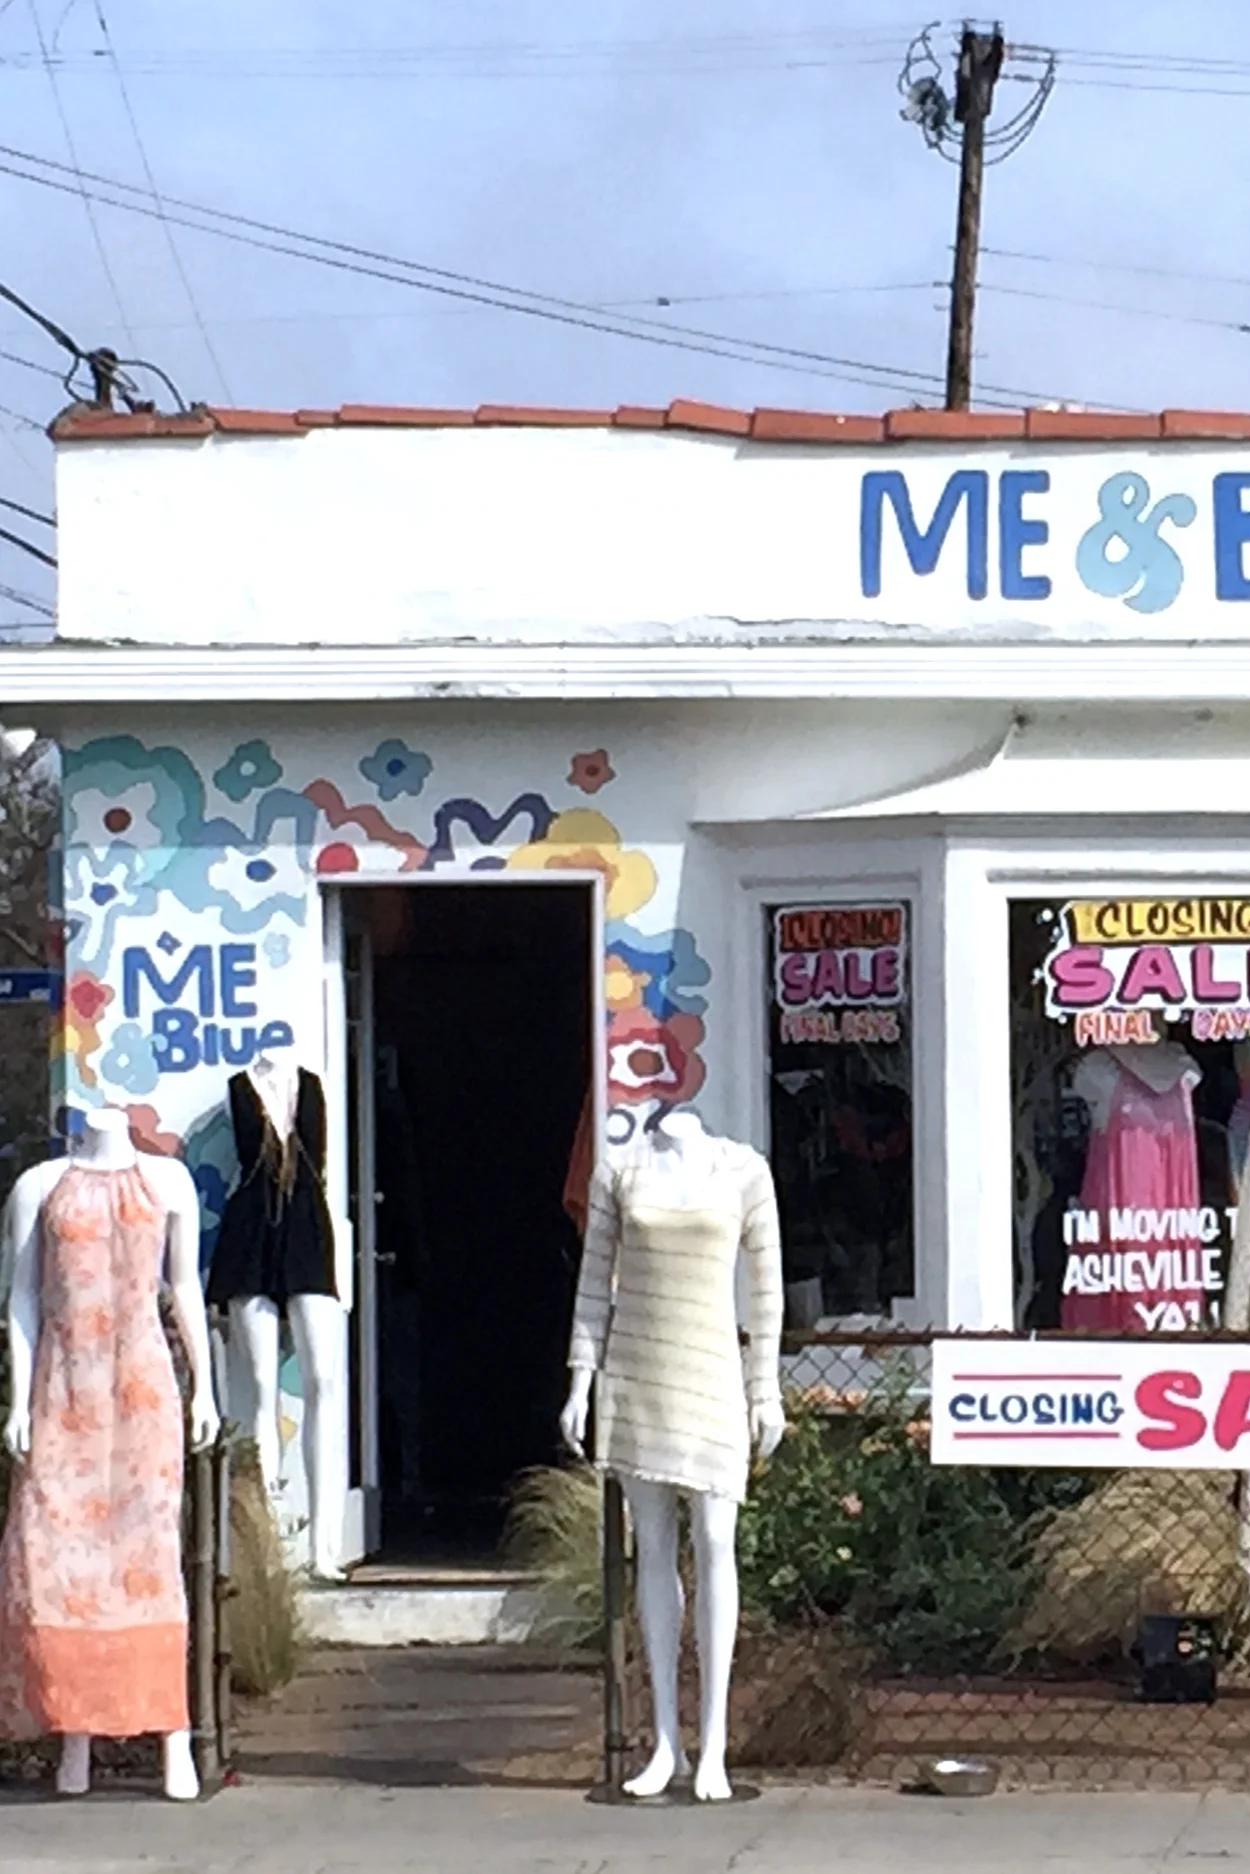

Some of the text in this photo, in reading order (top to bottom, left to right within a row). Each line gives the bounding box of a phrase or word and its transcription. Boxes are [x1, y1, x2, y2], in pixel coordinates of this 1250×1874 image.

[860, 470, 1052, 601] ME
[1075, 471, 1197, 614] &
[122, 943, 258, 1018] ME
[781, 949, 899, 1005] SALE
[1075, 1010, 1160, 1047] FINAL
[1063, 1208, 1099, 1245] I'M
[1109, 1206, 1220, 1243] MOVING
[1062, 1249, 1224, 1295] ASHEVILLE
[948, 1391, 1125, 1425] CLOSING
